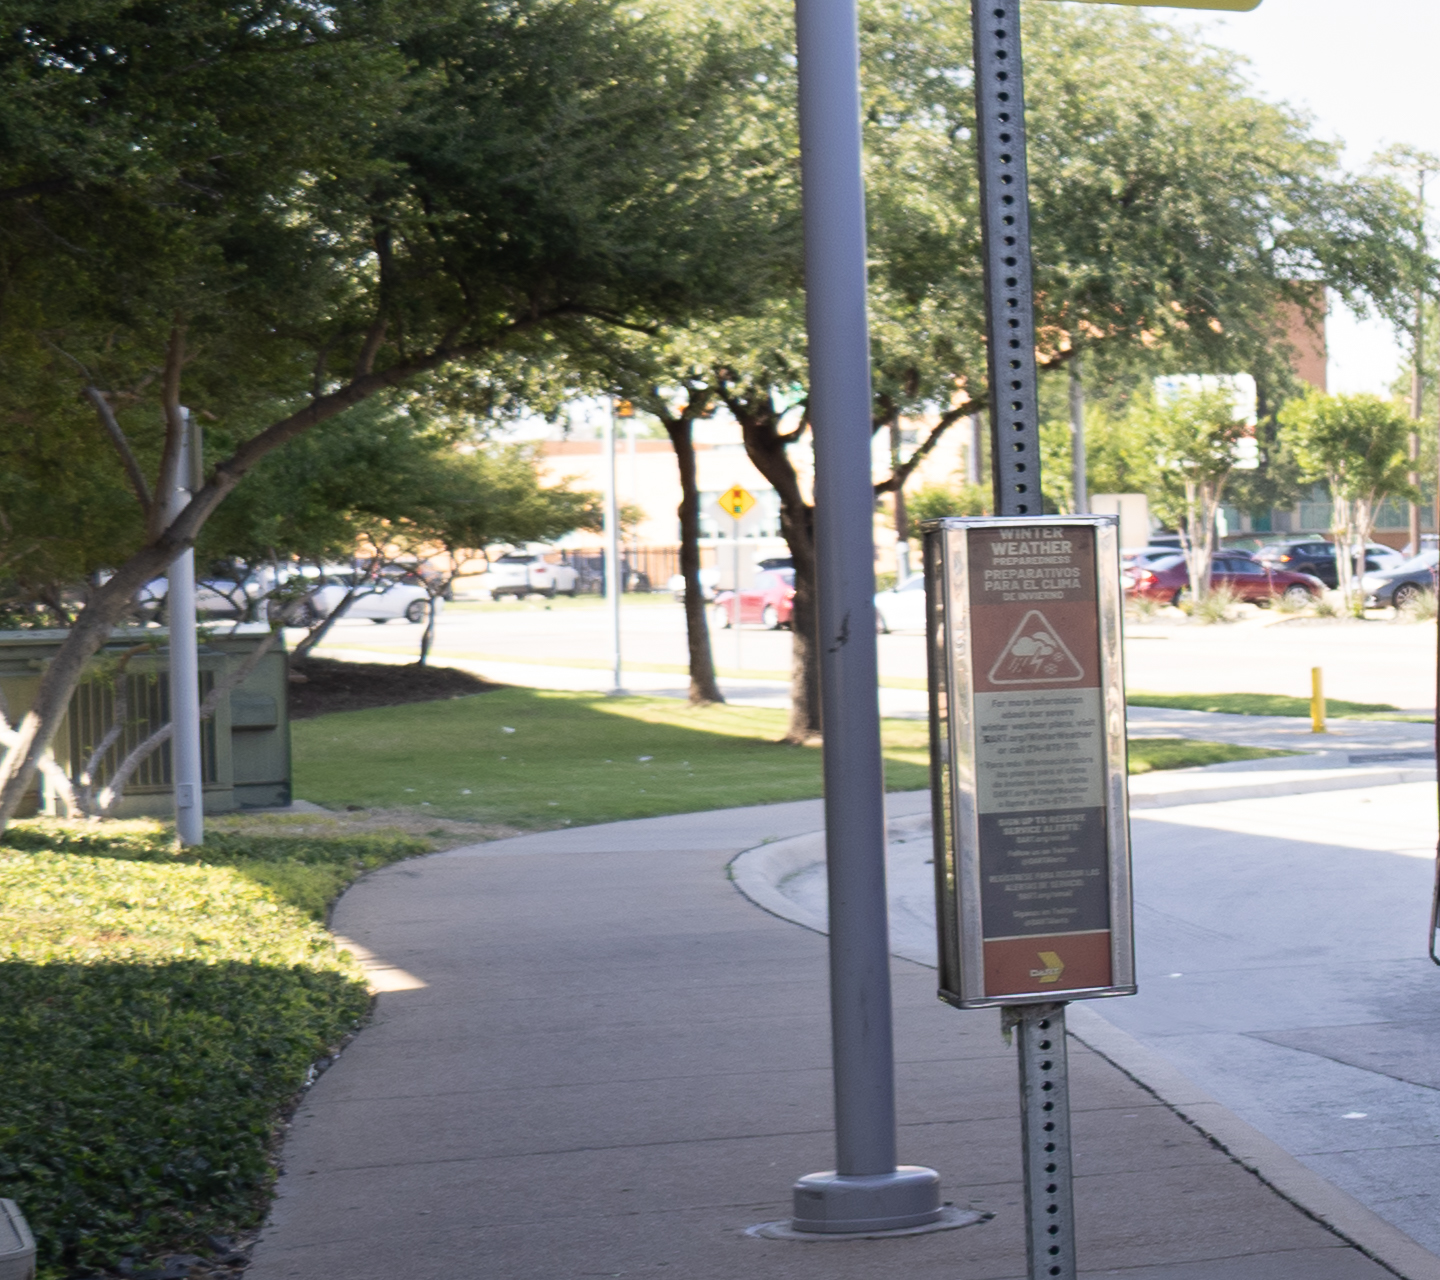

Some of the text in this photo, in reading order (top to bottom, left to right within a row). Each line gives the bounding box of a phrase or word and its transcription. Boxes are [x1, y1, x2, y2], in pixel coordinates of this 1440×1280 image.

[999, 527, 1064, 540] WINTER
[990, 540, 1073, 556] WEATHER
[992, 555, 1071, 566] PREPAREDNESS
[984, 567, 1082, 580] PREPARATIVOS
[984, 578, 1081, 592] PARA EL CLIMA
[1002, 591, 1064, 601] DE INVIERNO
